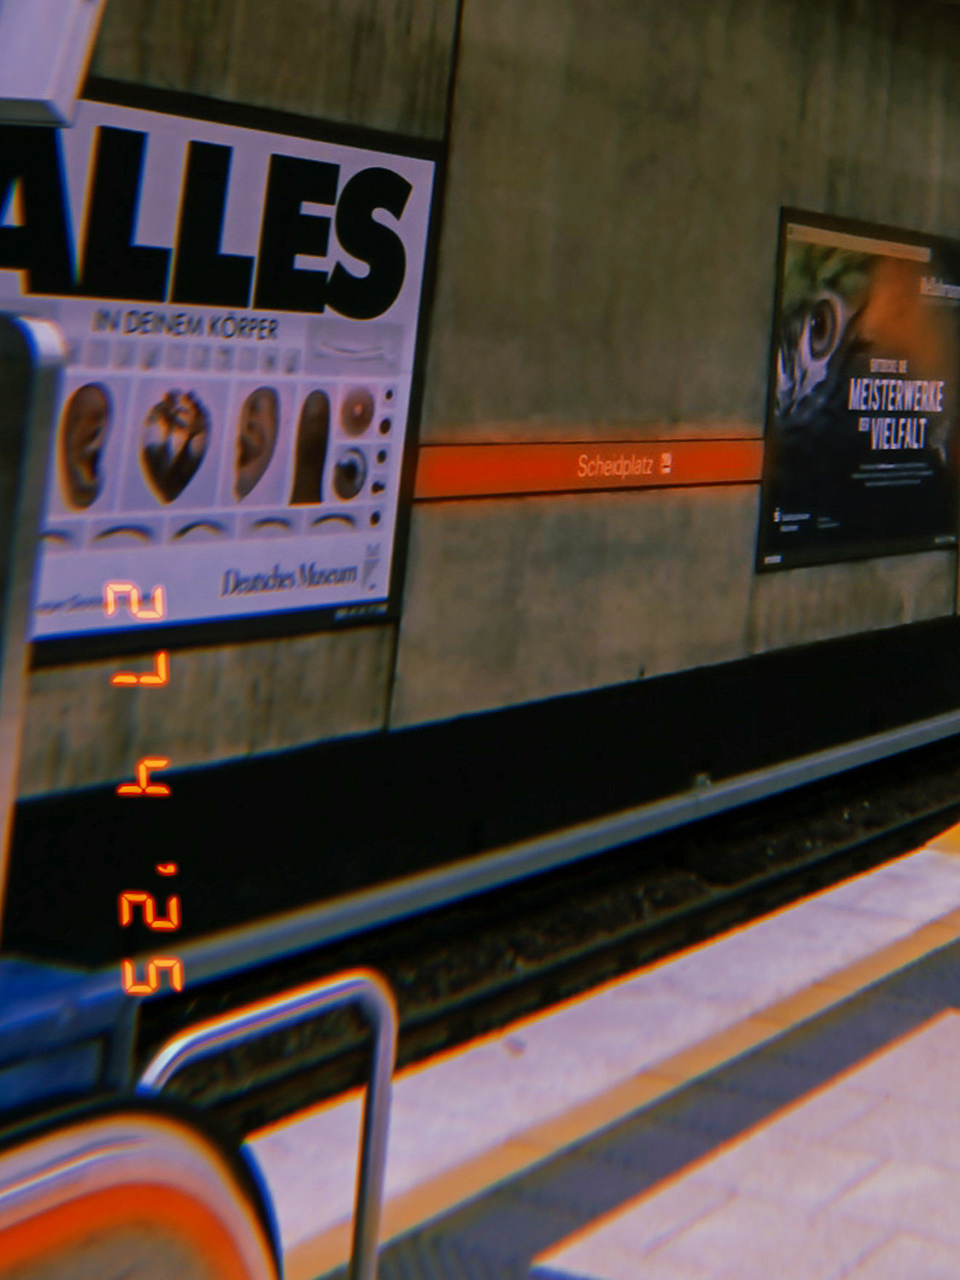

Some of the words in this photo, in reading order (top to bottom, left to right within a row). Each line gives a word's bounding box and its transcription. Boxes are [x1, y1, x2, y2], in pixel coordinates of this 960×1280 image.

[0, 125, 413, 320] ALLES
[122, 309, 202, 337] DEINEM
[848, 377, 944, 412] MEISTERWERKE
[871, 417, 927, 450] VIELFALT
[577, 453, 654, 480] Scheidplatz
